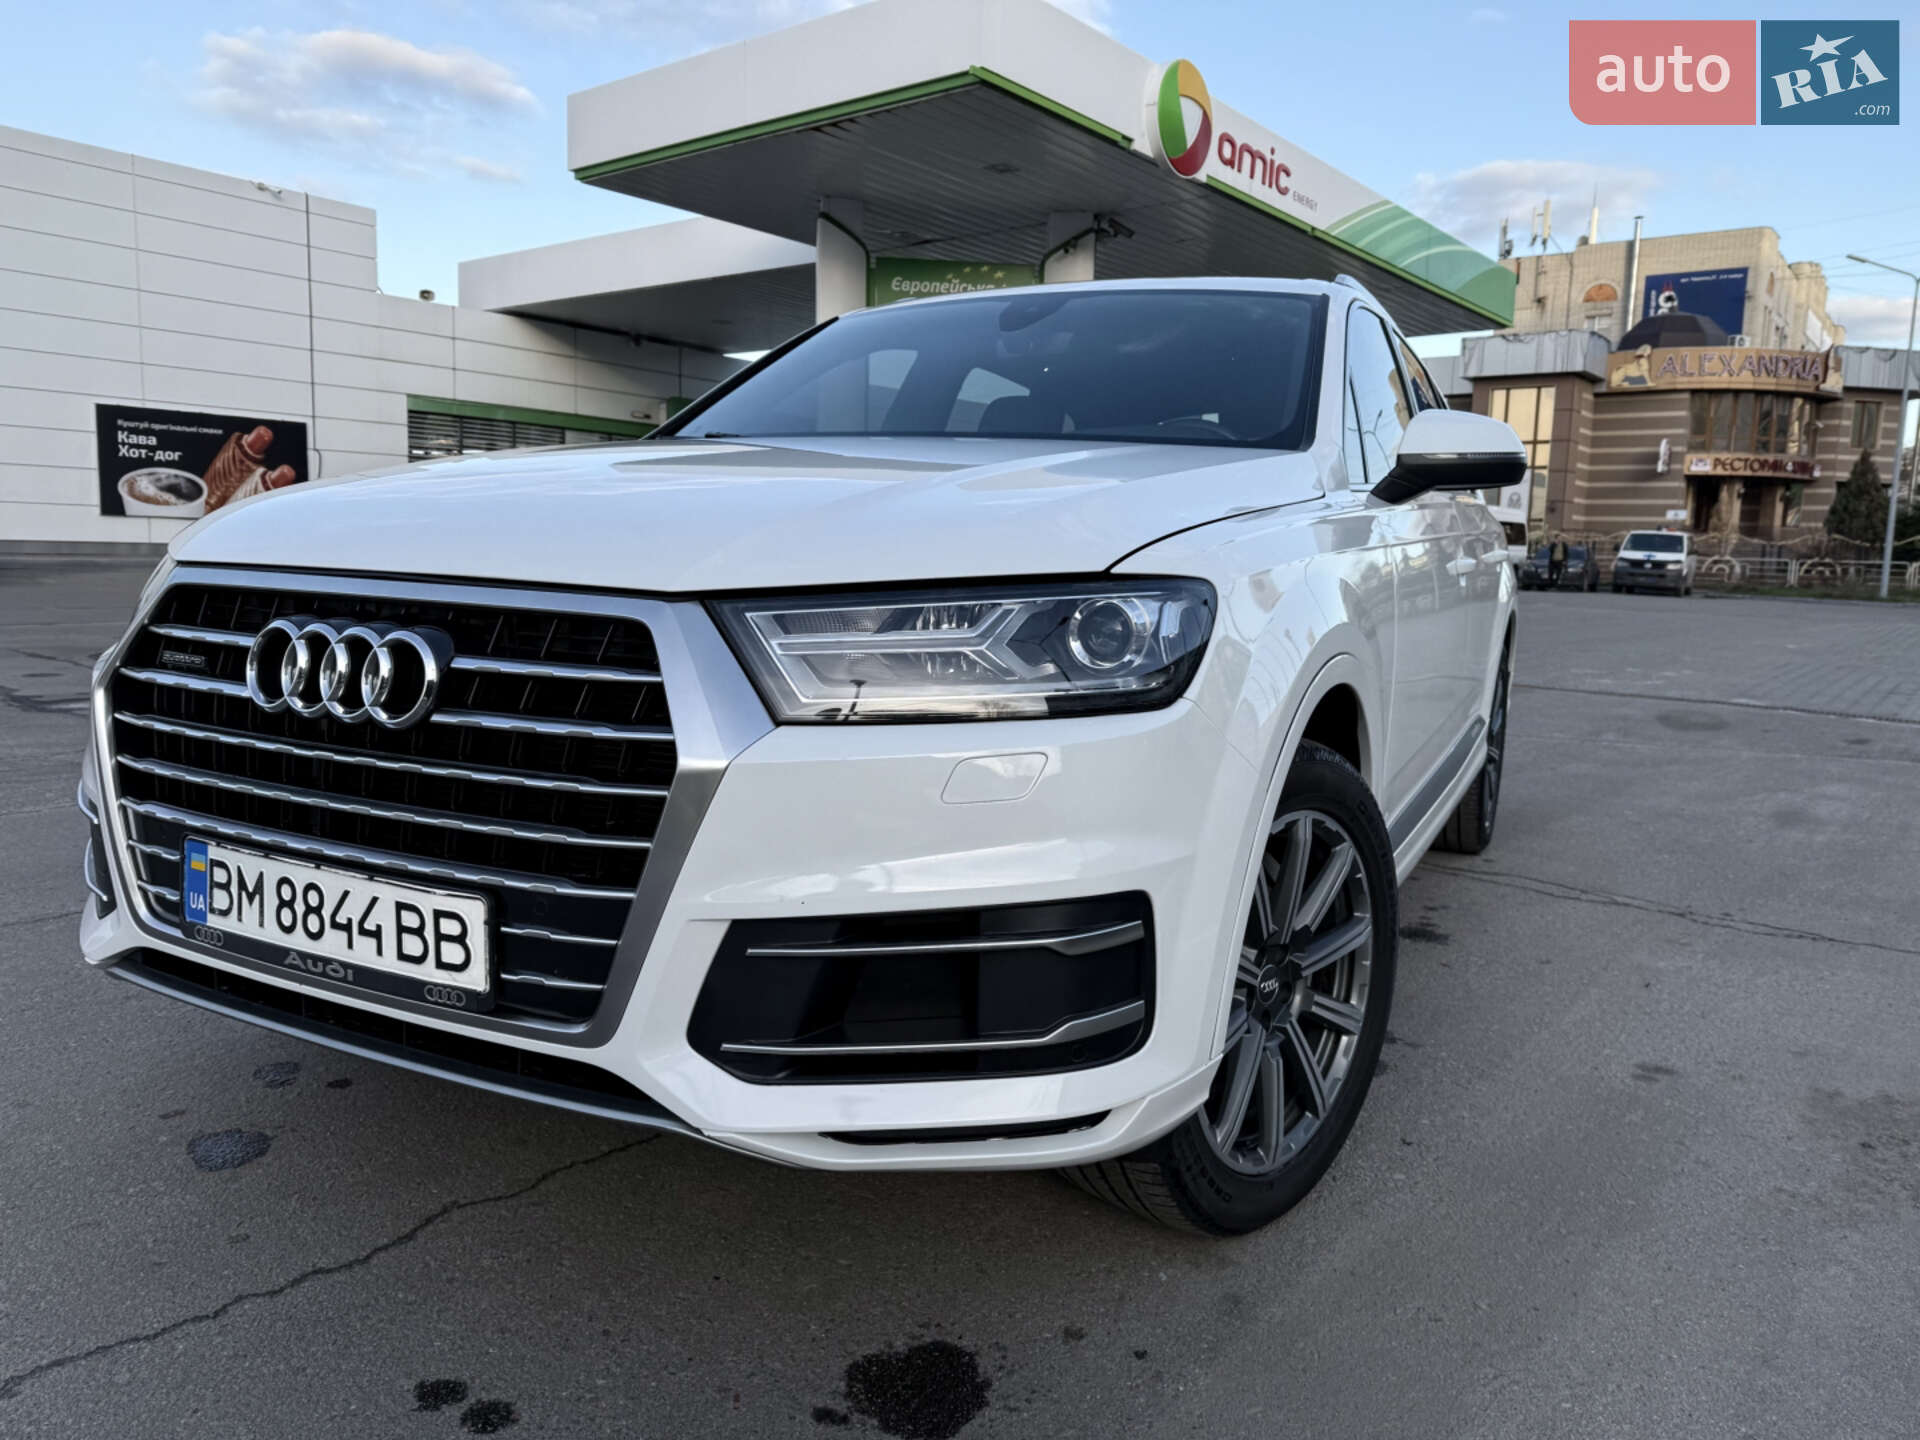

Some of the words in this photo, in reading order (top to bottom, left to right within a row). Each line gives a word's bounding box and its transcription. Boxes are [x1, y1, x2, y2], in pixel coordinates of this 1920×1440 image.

[1217, 131, 1292, 196] amic
[1656, 351, 1824, 383] ALEXANDRIA
[117, 430, 157, 446] Кава
[118, 444, 183, 462] Хот-дог
[189, 891, 206, 912] UA
[283, 950, 355, 982] Audi
